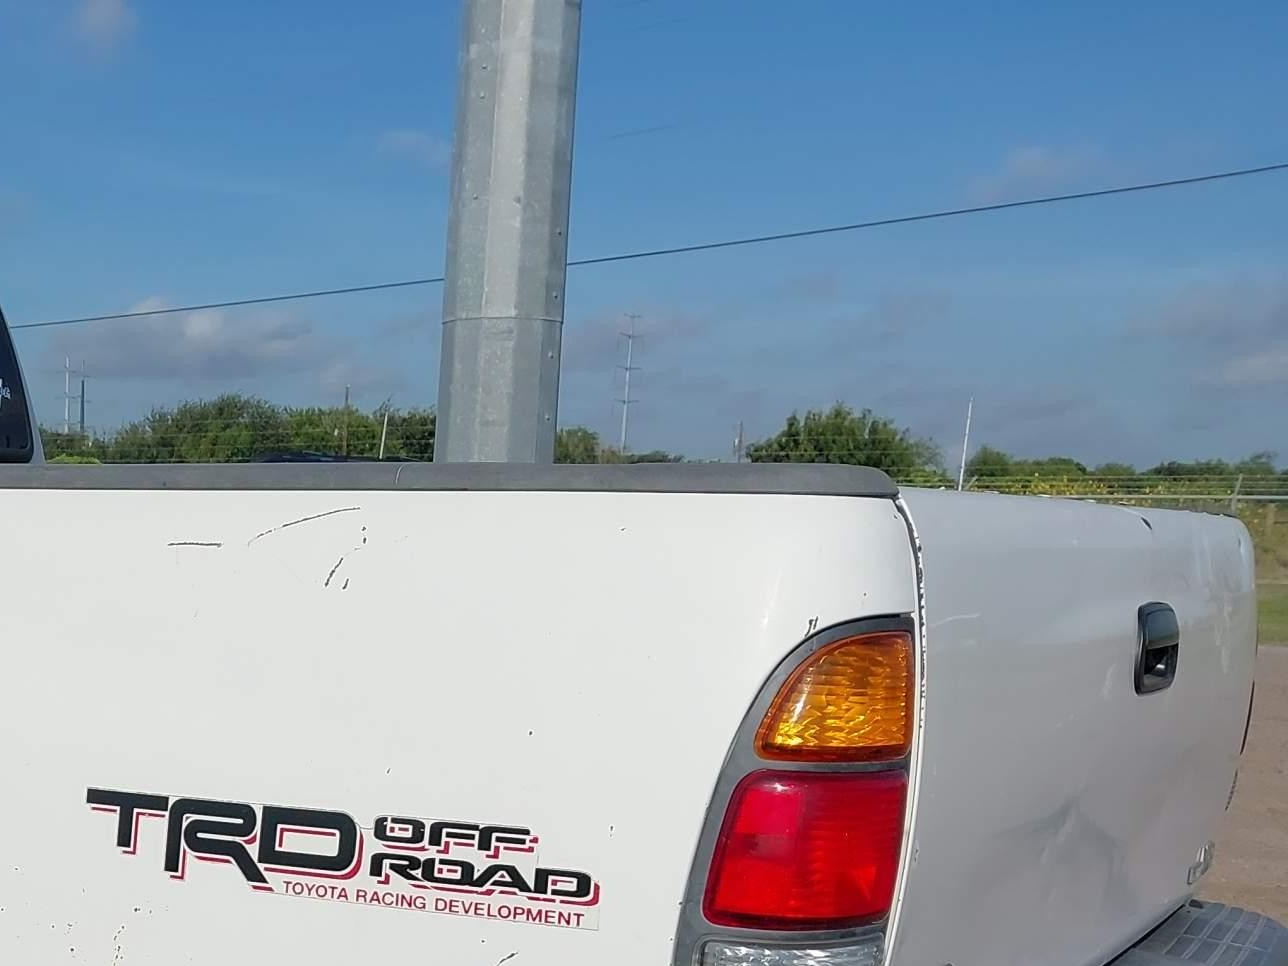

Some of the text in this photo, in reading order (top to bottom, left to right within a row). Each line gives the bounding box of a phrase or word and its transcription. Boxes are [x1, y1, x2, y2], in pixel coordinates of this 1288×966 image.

[86, 787, 364, 891] TRD
[373, 814, 538, 859] OFF
[282, 879, 585, 928] TOYOTA RACING DEVELOPMENT
[368, 852, 600, 907] ROAD
